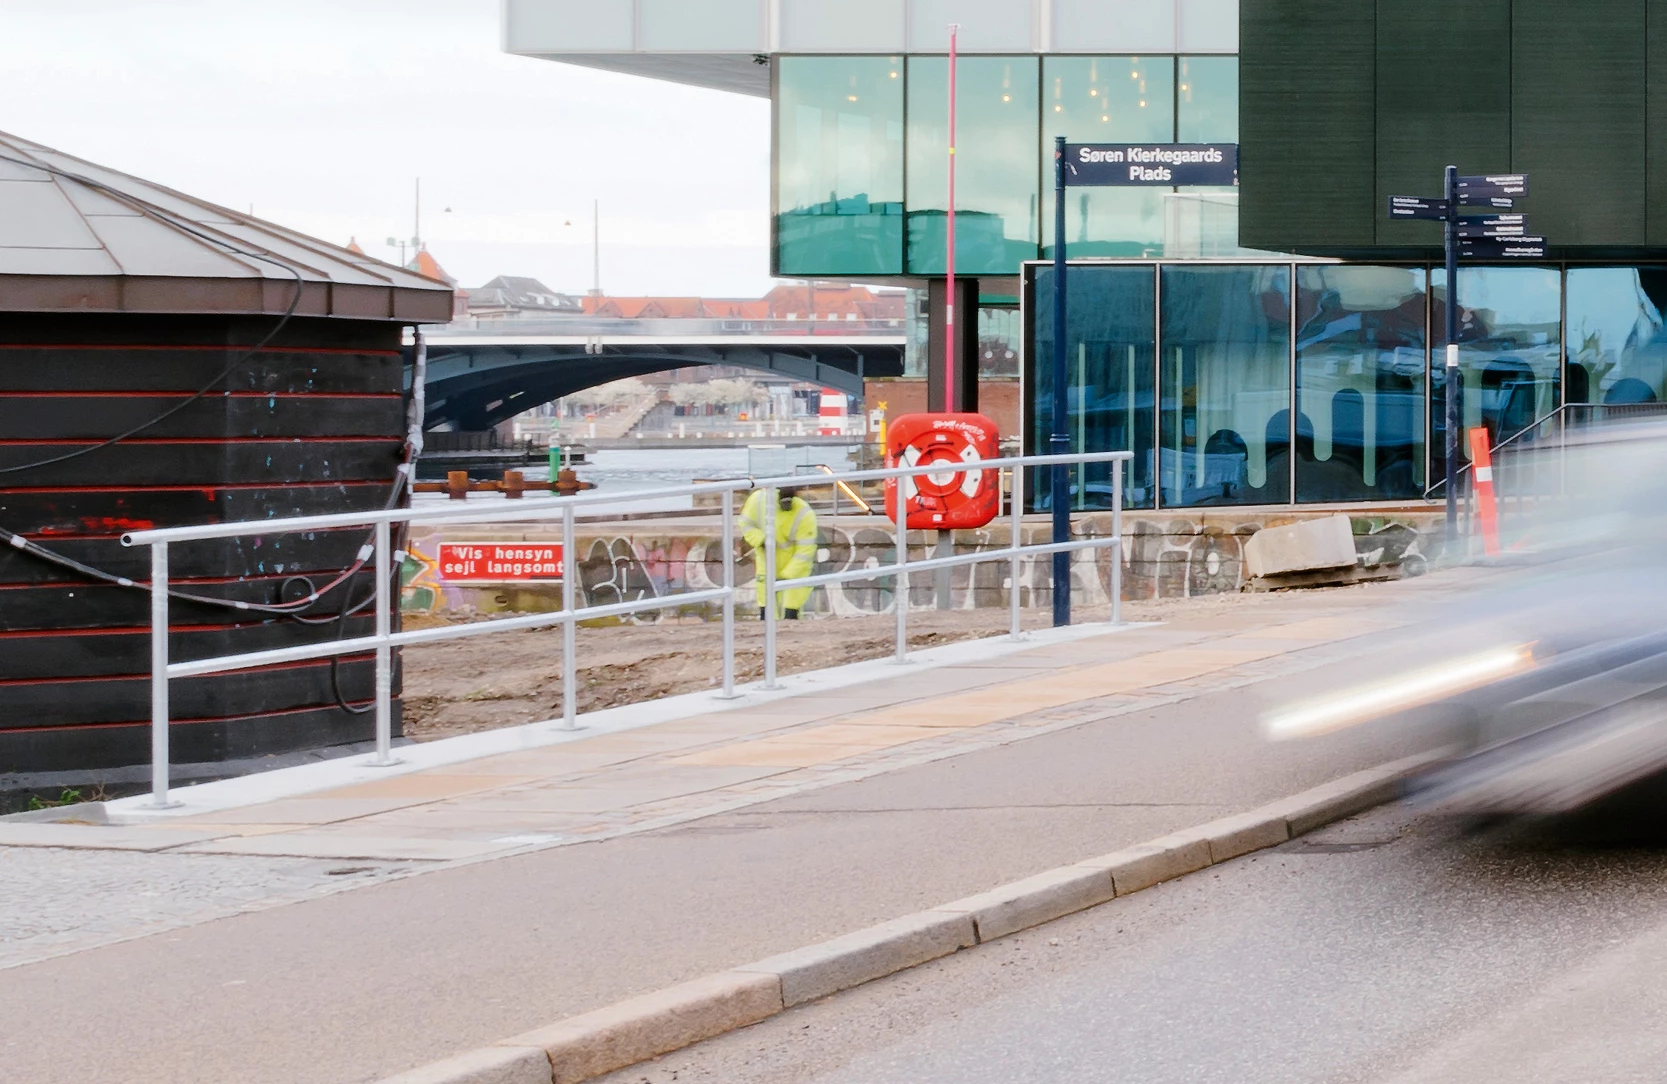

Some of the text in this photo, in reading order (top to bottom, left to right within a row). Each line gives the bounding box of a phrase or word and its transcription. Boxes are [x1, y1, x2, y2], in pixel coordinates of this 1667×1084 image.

[1079, 147, 1223, 165] Søren Kierkegaards
[1129, 166, 1172, 181] Plads
[457, 547, 553, 561] Vis hensyn
[445, 561, 564, 575] sejl langsomt
